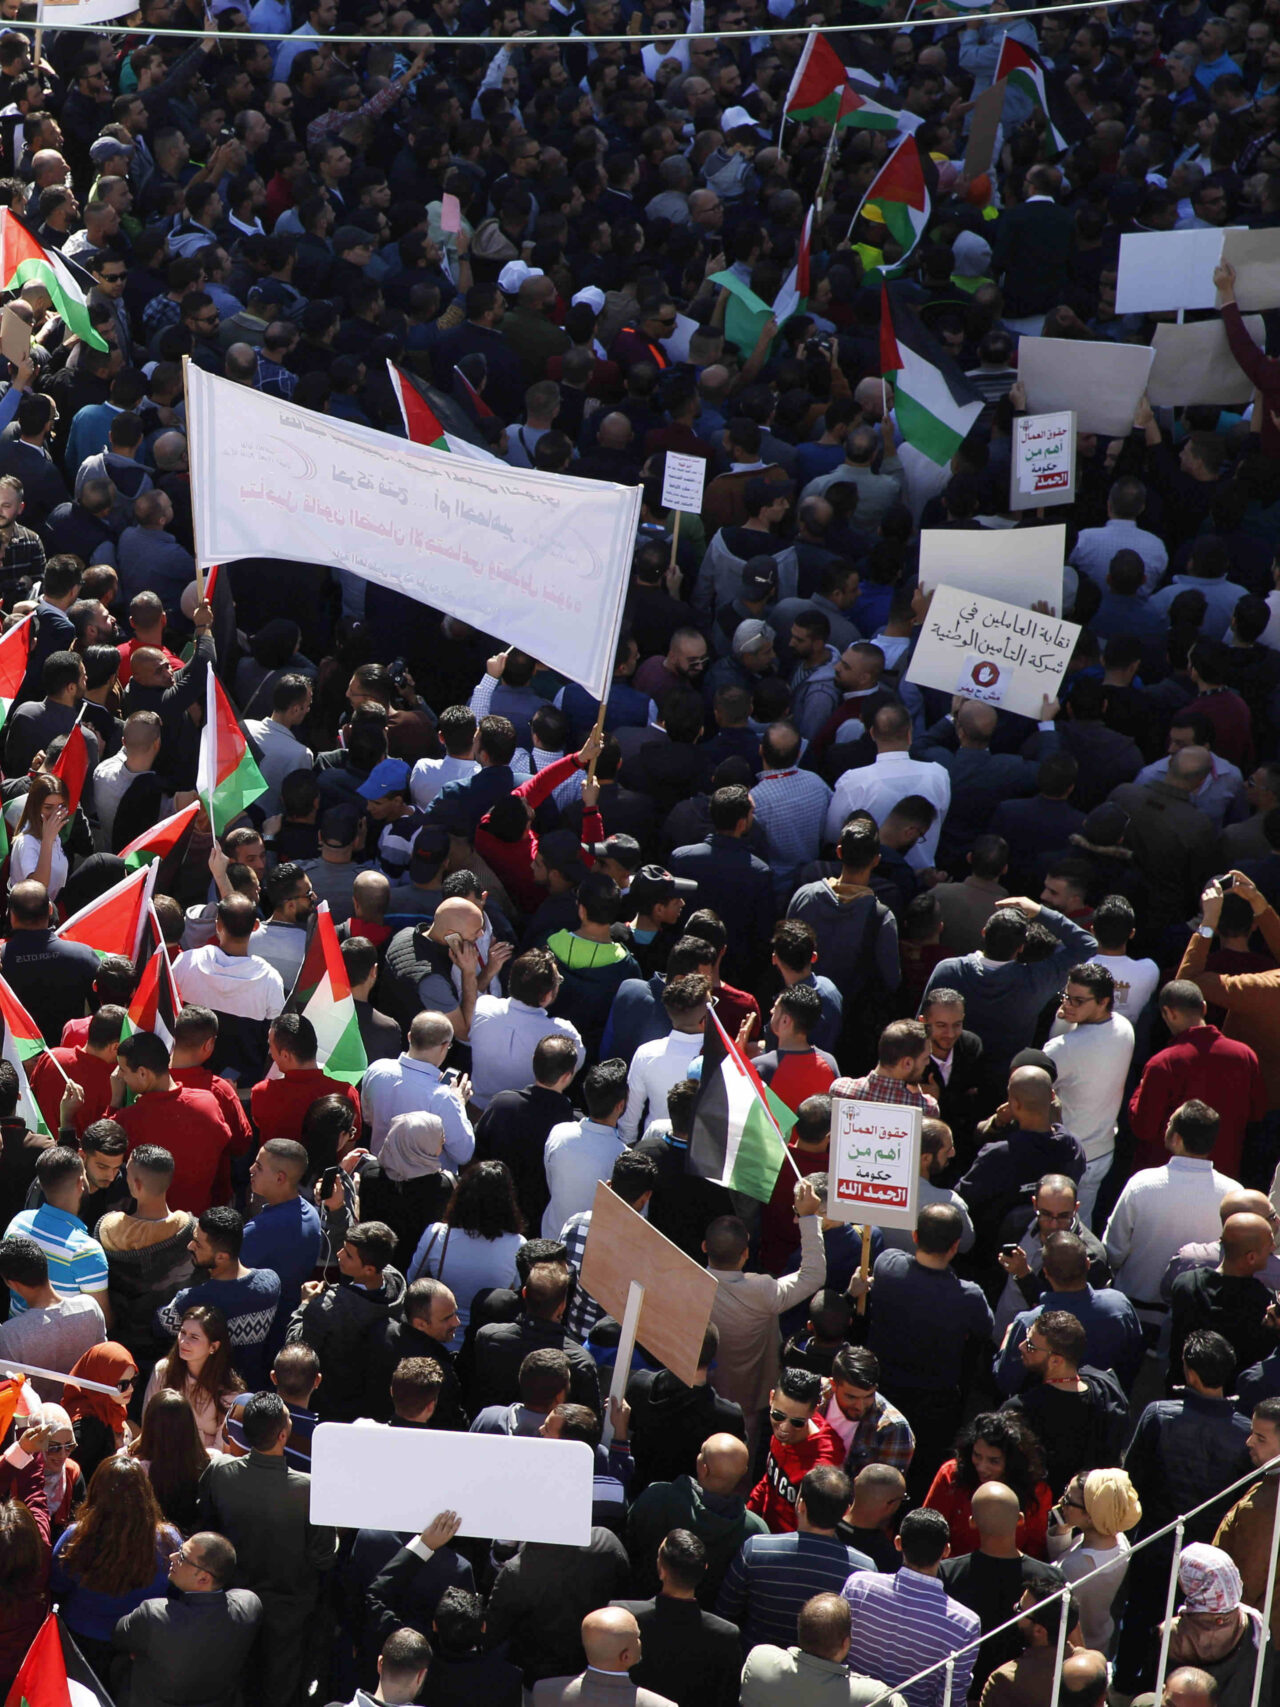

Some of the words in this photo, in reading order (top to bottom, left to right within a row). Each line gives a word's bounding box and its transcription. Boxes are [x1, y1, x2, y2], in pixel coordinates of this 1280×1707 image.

[1021, 430, 1046, 444] العمال
[1047, 428, 1068, 440] حقوق
[1025, 448, 1042, 461] من
[1031, 462, 1058, 473] حكومة
[959, 602, 979, 621] في
[982, 610, 1038, 639] العاملين
[930, 619, 979, 649] الوطنية
[1038, 624, 1070, 649] نقابة
[978, 637, 1027, 666] التأمين
[1028, 654, 1064, 674] شركة
[842, 1122, 878, 1135] العمال
[879, 1126, 909, 1140] حقوق
[847, 1144, 872, 1160] من
[874, 1142, 902, 1163] أهم
[856, 1165, 892, 1182] حكومة
